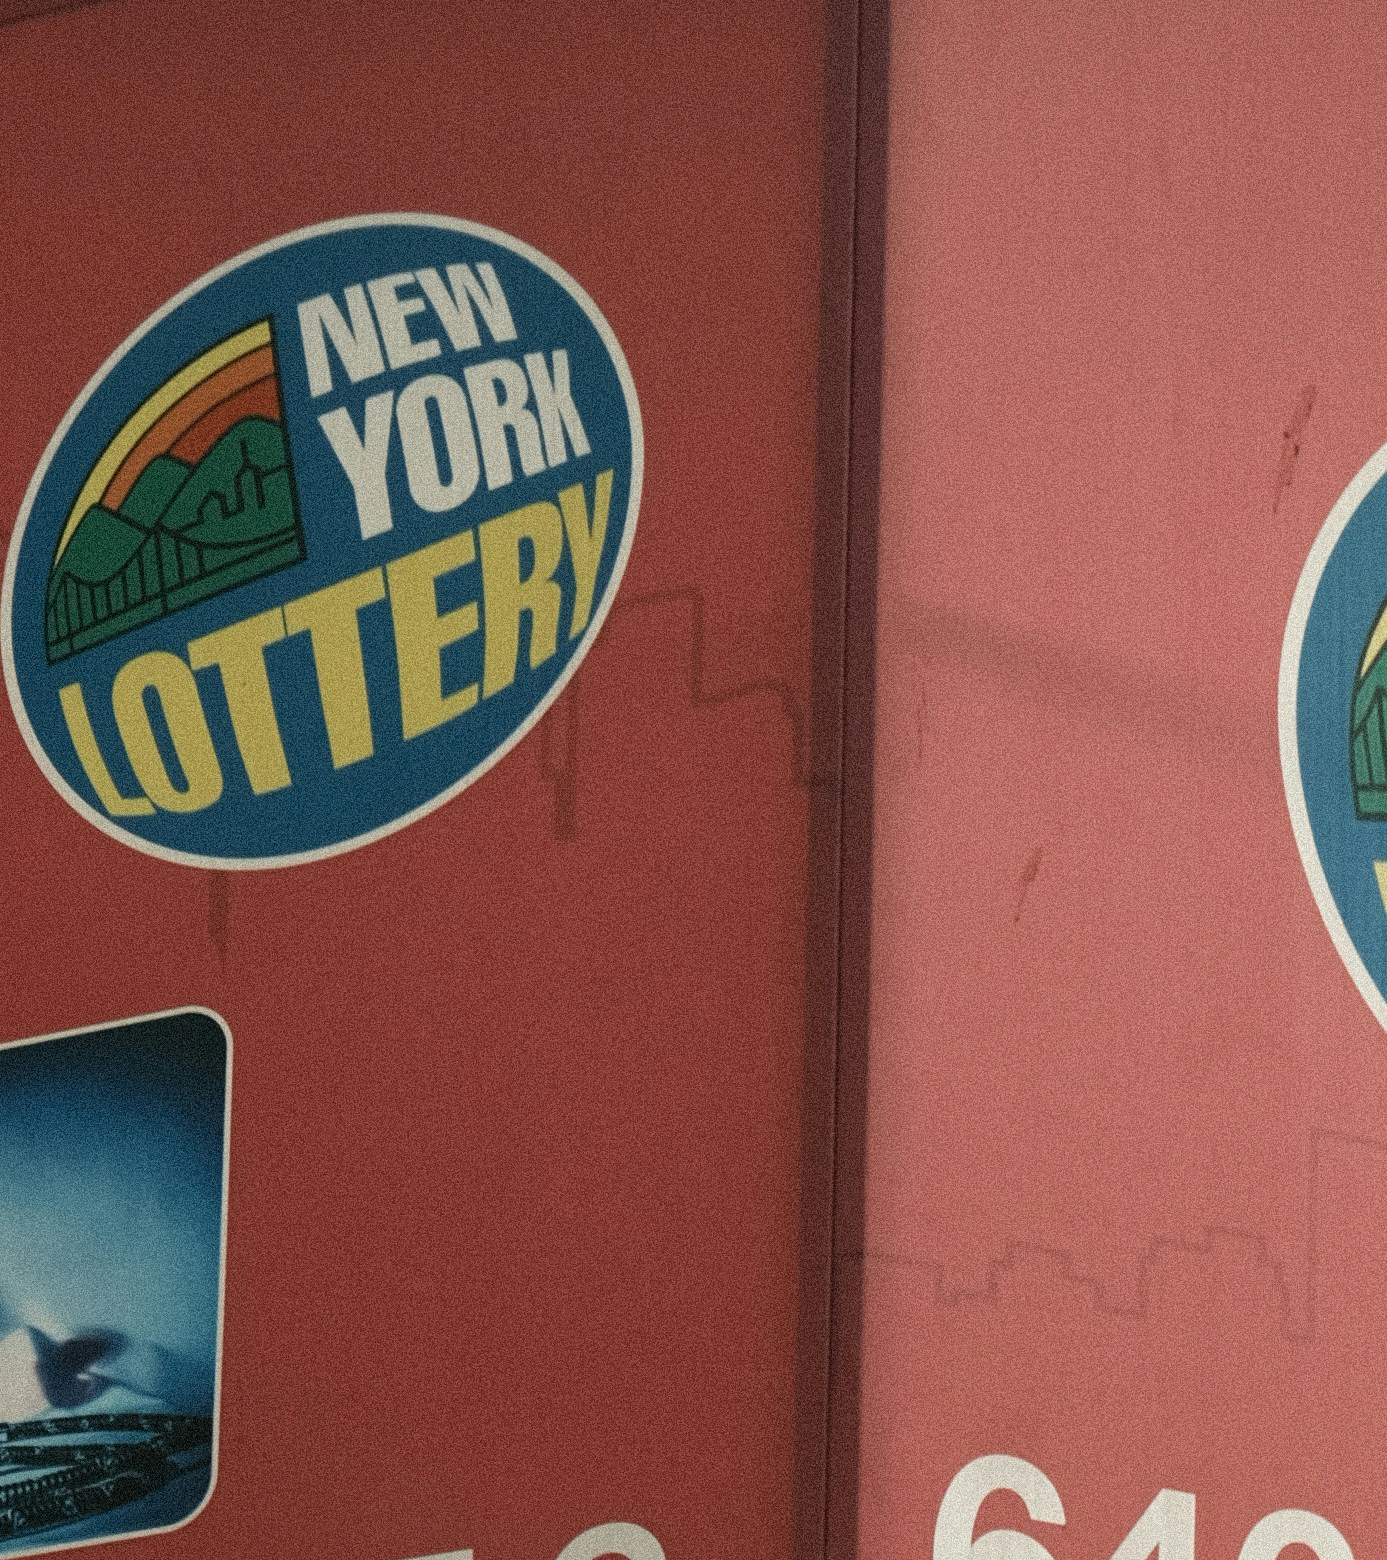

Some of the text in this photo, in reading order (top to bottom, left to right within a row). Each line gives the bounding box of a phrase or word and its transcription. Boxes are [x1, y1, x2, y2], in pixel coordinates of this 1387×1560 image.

[297, 260, 513, 400] NEW
[318, 349, 592, 544] YORK
[56, 470, 615, 820] LOTTERY
